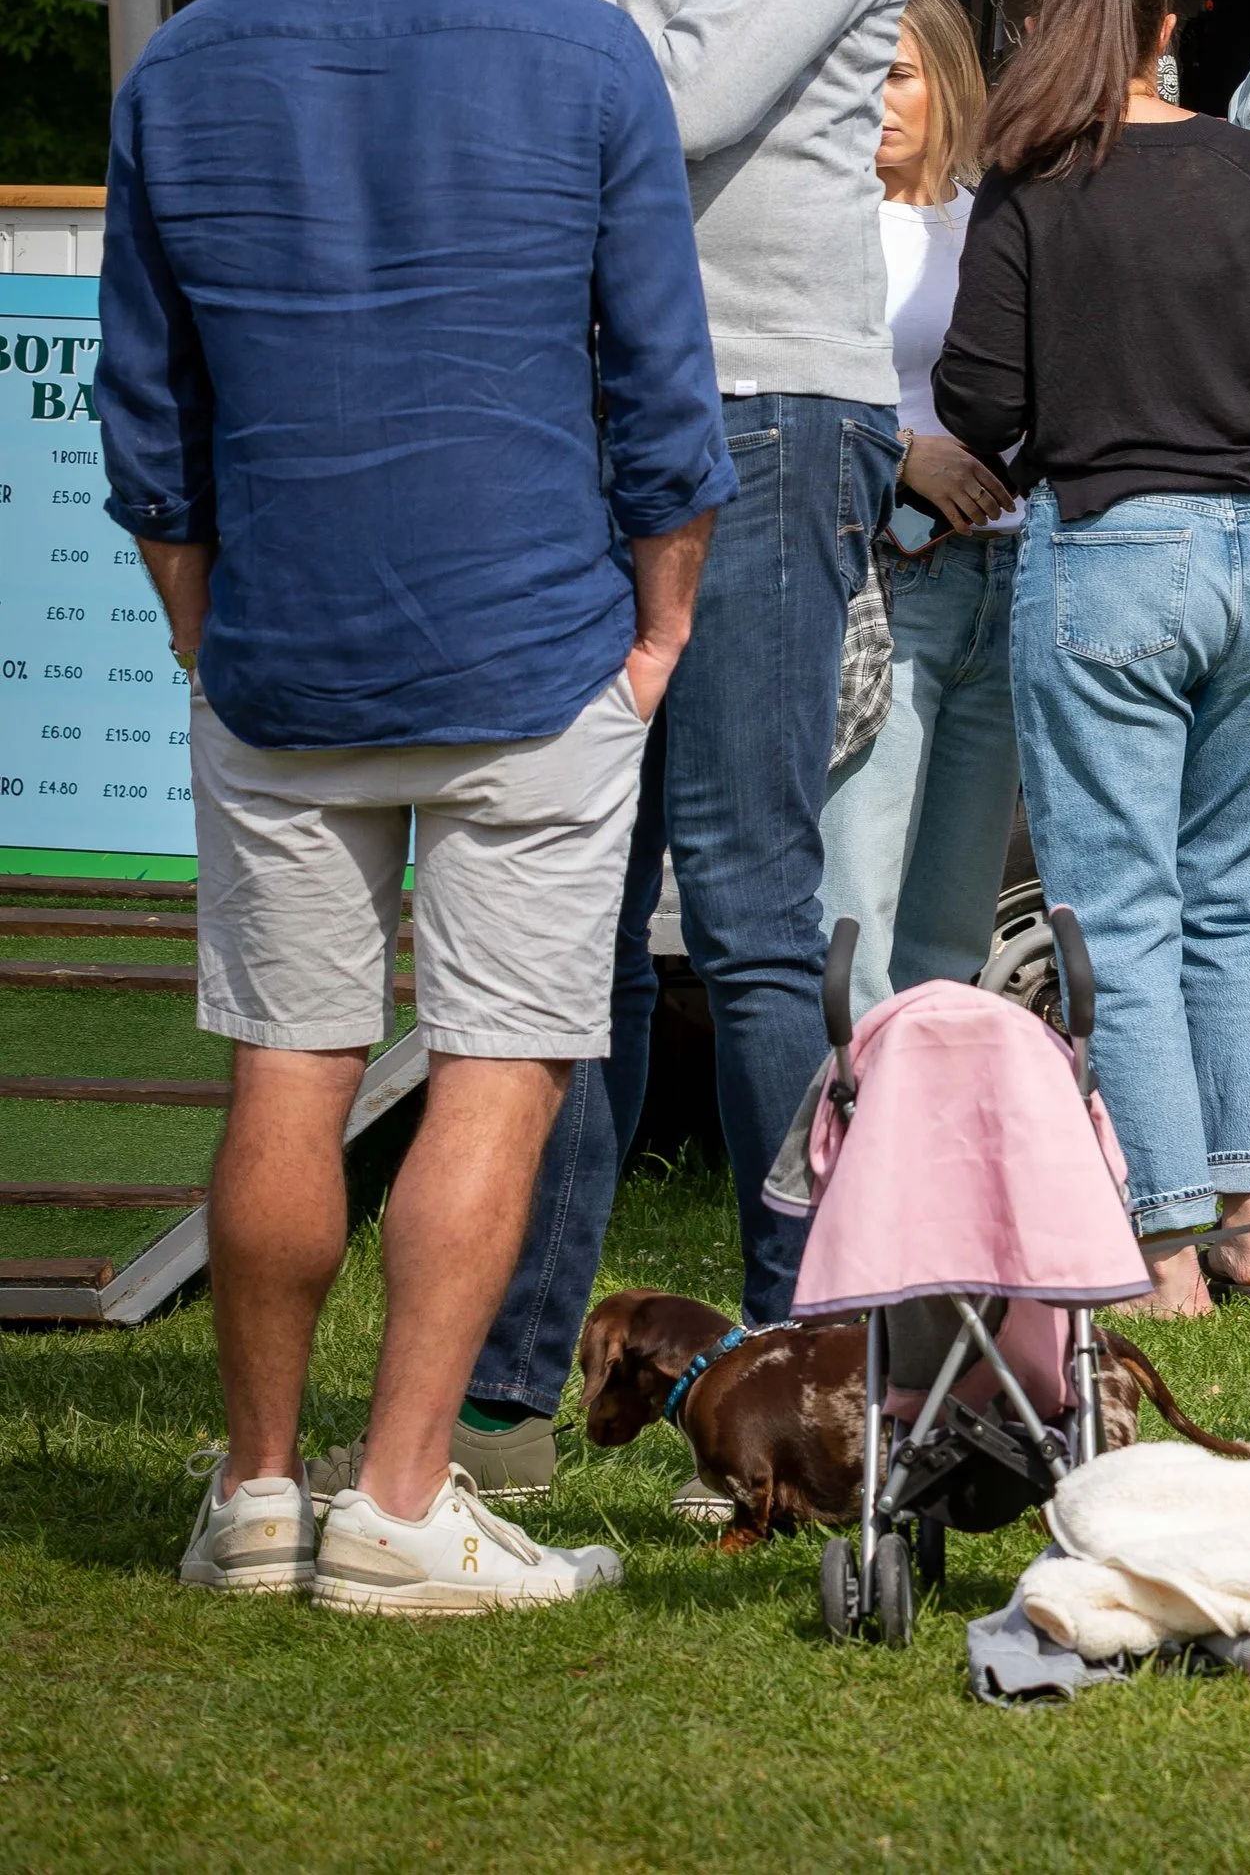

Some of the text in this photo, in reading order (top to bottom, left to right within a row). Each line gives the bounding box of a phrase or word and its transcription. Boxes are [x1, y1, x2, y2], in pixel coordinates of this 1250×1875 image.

[52, 450, 98, 465] 1 BOTTLE
[0, 484, 91, 505] R £5.00
[50, 548, 89, 563] £5.00
[46, 606, 157, 623] £6.70 £18.00
[44, 664, 83, 680] £5.60
[108, 667, 153, 683] £15.00
[41, 724, 81, 740] £6.00
[105, 728, 151, 743] £15.00
[0, 776, 24, 797] RO
[38, 780, 78, 795] £4.80
[103, 783, 147, 799] £12.00
